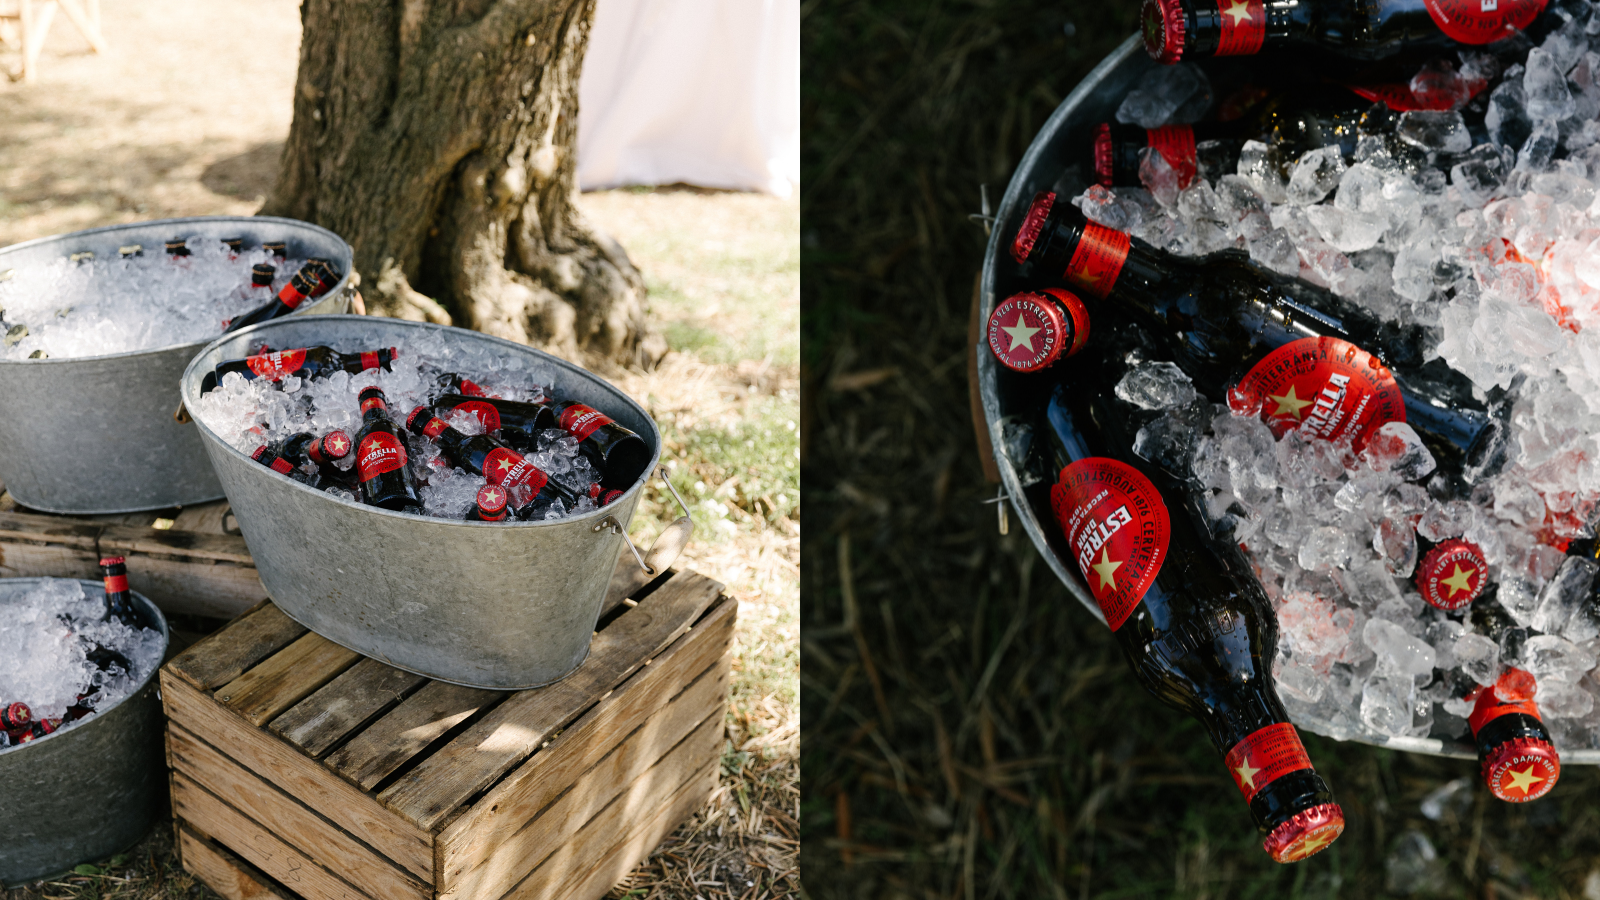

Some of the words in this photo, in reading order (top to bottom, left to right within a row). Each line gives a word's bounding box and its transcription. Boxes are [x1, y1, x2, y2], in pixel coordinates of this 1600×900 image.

[1017, 301, 1053, 335] ESTRELLA
[990, 319, 1010, 364] ORIGINAL
[1033, 337, 1054, 364] DAMM
[1301, 372, 1350, 436] TRELLA
[1343, 393, 1372, 434] ORIGINAL
[361, 448, 397, 466] ESTRELLA
[1093, 471, 1137, 494] AUGUST
[1068, 506, 1082, 525] 1876
[1079, 489, 1109, 518] RECETA
[1133, 495, 1150, 516] 1876
[1076, 518, 1098, 548] DAMM
[1130, 521, 1154, 579] CERVEZA
[1451, 552, 1486, 573] ESTRELLA
[1470, 573, 1486, 599] DAMM
[1429, 577, 1450, 608] ORIGINAL
[1513, 755, 1542, 763] DAMM
[1523, 774, 1556, 802] ORIGINAL
